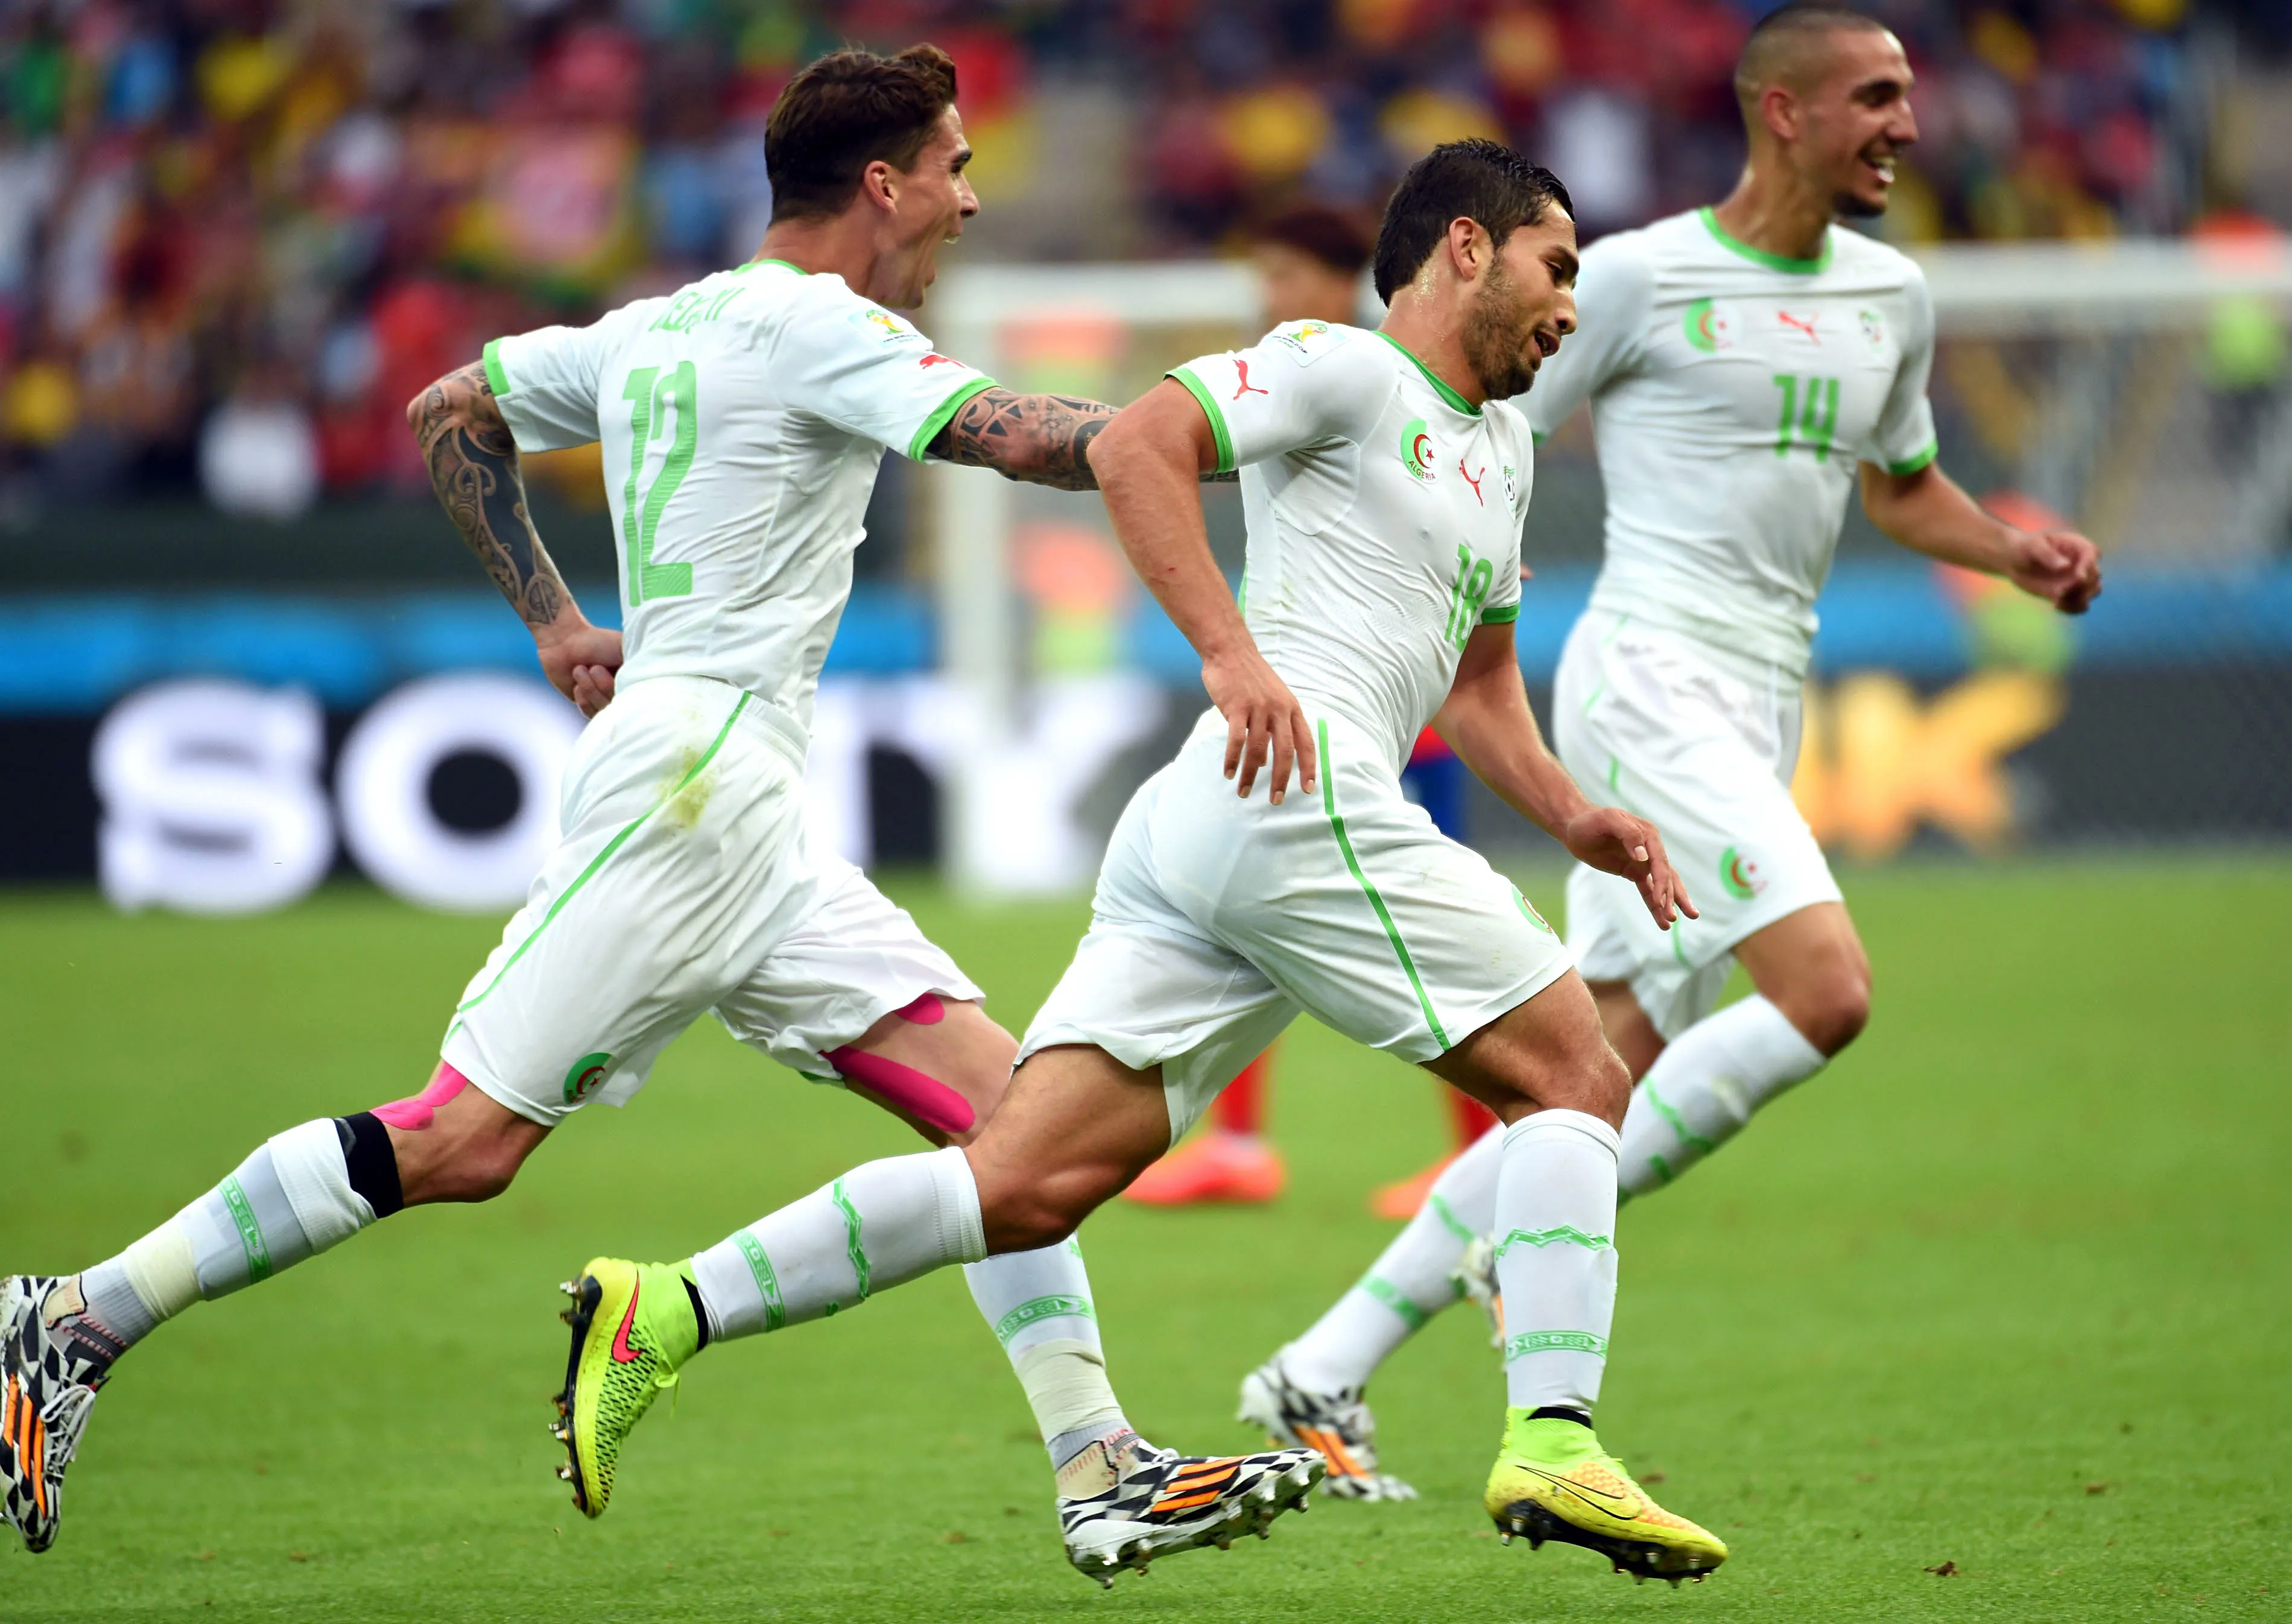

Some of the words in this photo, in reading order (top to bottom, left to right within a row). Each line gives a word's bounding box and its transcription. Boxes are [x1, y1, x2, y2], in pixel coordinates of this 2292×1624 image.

[1408, 460, 1436, 481] ALGERIA
[1772, 374, 1841, 464] 14
[622, 361, 697, 607] 12
[1445, 543, 1493, 652] 18
[93, 671, 1168, 914] SOY
